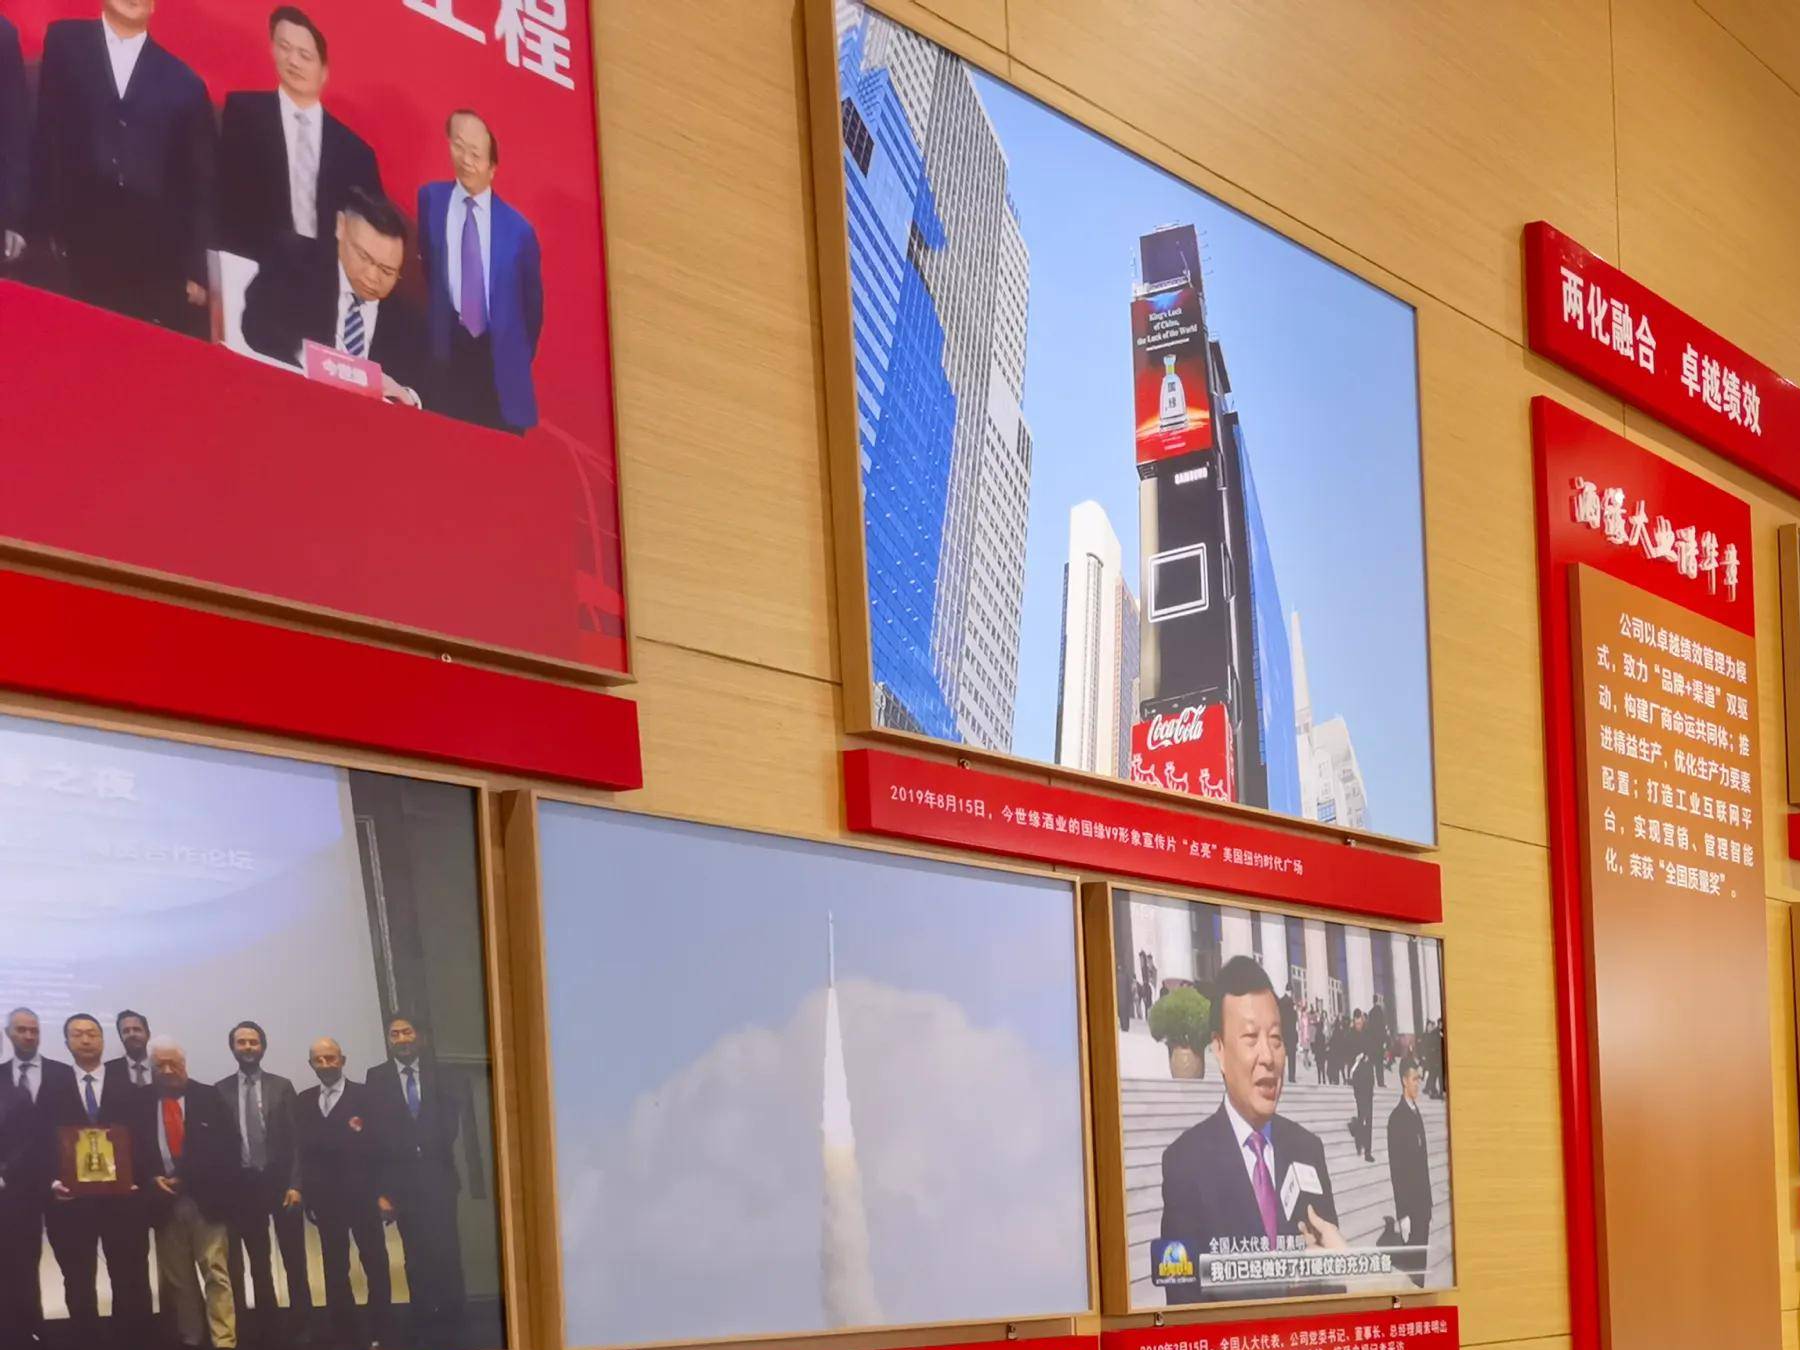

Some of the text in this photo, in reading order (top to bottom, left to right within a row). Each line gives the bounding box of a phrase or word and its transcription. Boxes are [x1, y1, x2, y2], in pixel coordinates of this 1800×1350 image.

[1561, 266, 1762, 436] 两化融合 卓越绩效
